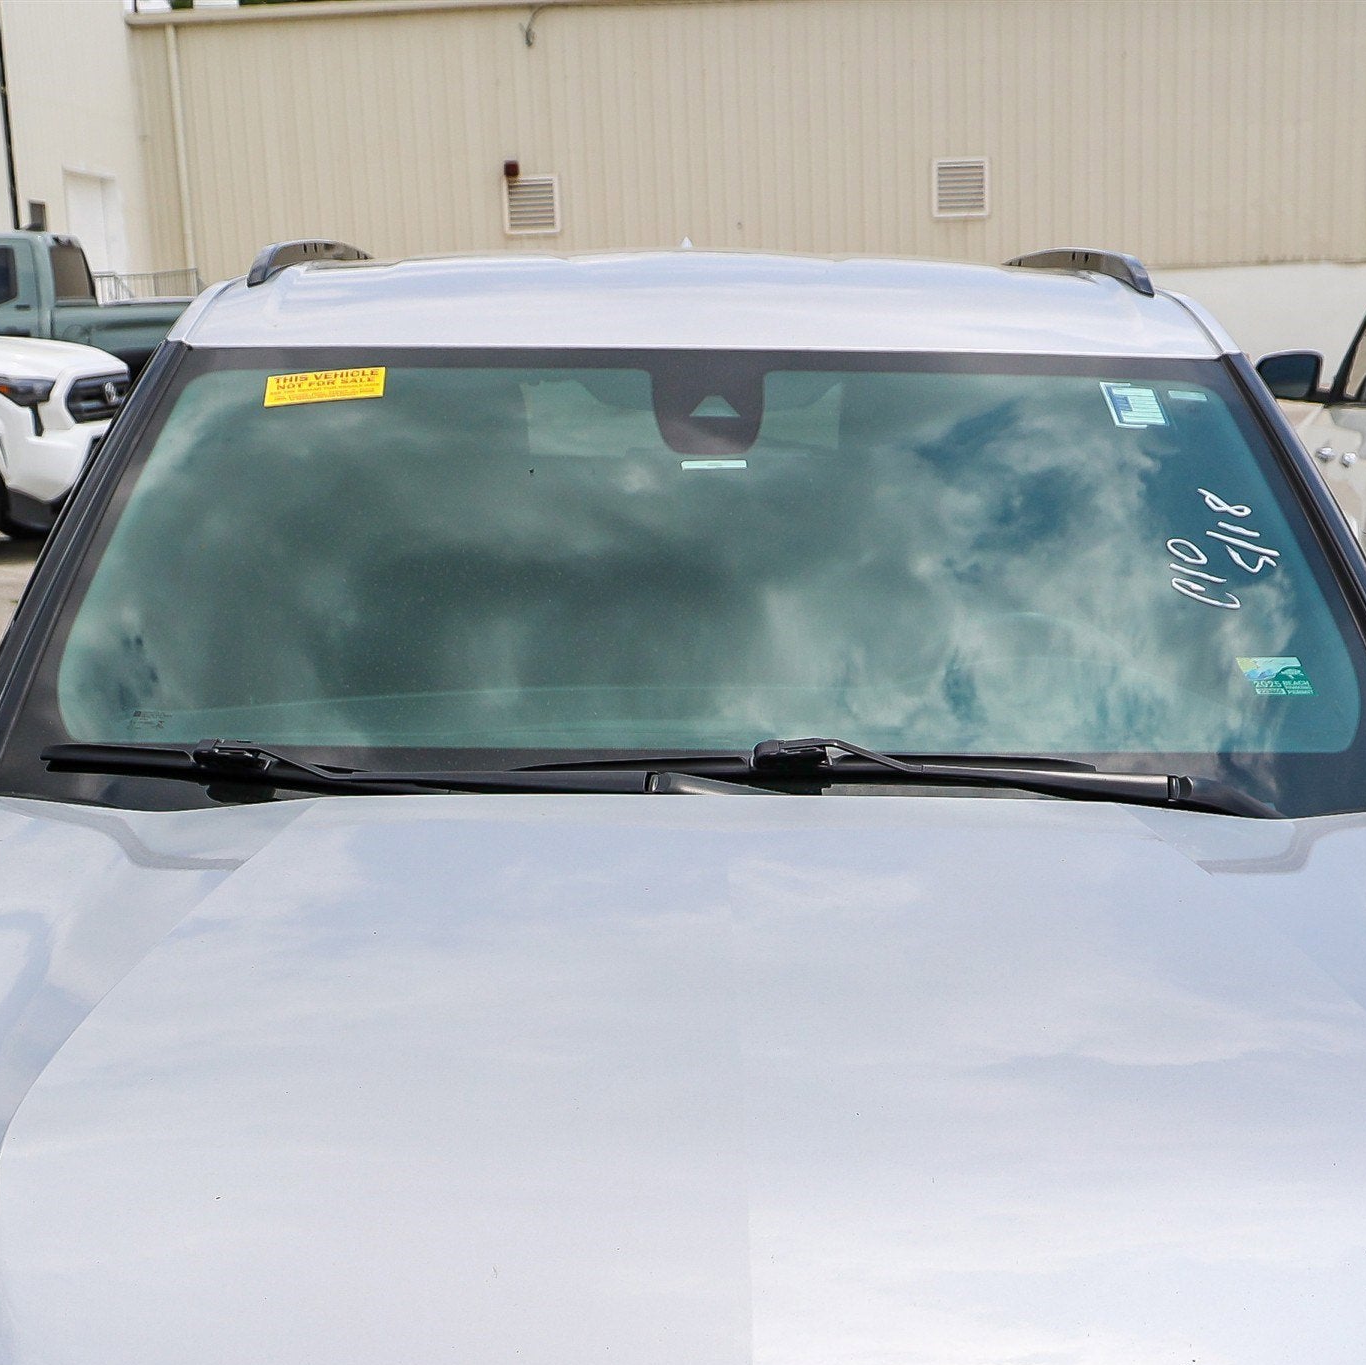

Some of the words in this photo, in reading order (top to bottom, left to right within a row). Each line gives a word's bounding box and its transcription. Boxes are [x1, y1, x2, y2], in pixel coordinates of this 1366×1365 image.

[274, 374, 308, 384] THIS
[314, 369, 379, 381] VEHICLE
[276, 382, 304, 391] NOT
[309, 379, 336, 388] FOR
[340, 376, 376, 385] SALE
[1197, 487, 1280, 574] 5/18
